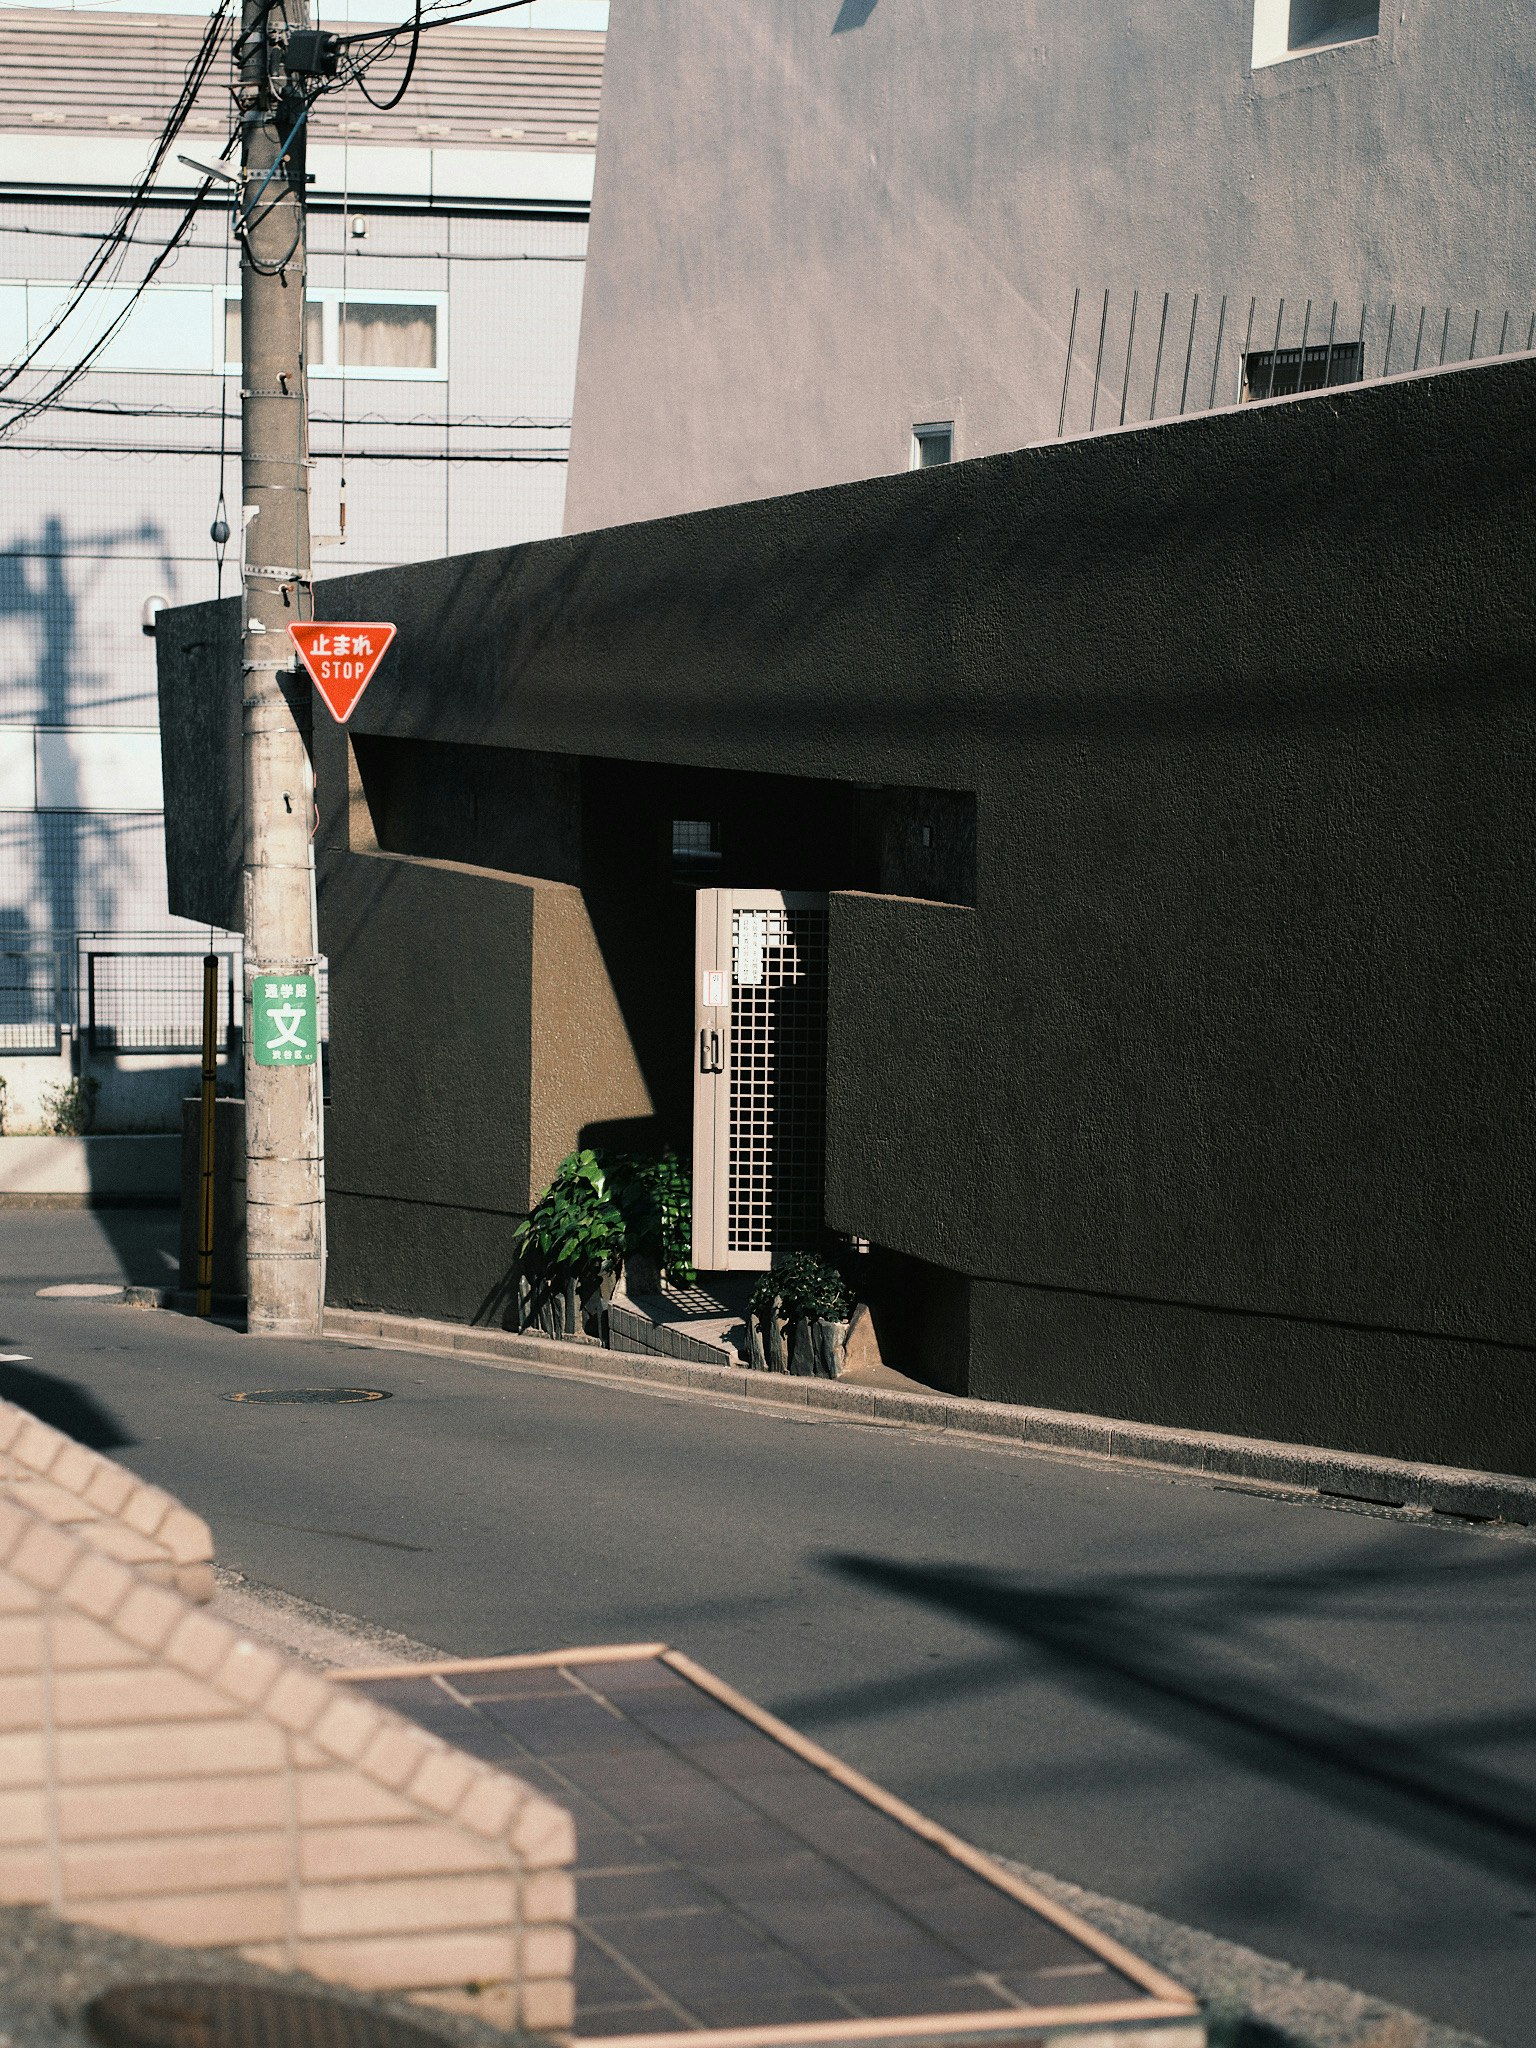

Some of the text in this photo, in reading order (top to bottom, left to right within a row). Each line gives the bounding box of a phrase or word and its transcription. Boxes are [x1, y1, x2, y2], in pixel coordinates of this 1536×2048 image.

[309, 633, 374, 656] 止まれ
[321, 660, 365, 679] STOP
[264, 983, 308, 999] 通学路
[266, 1002, 307, 1049] 文
